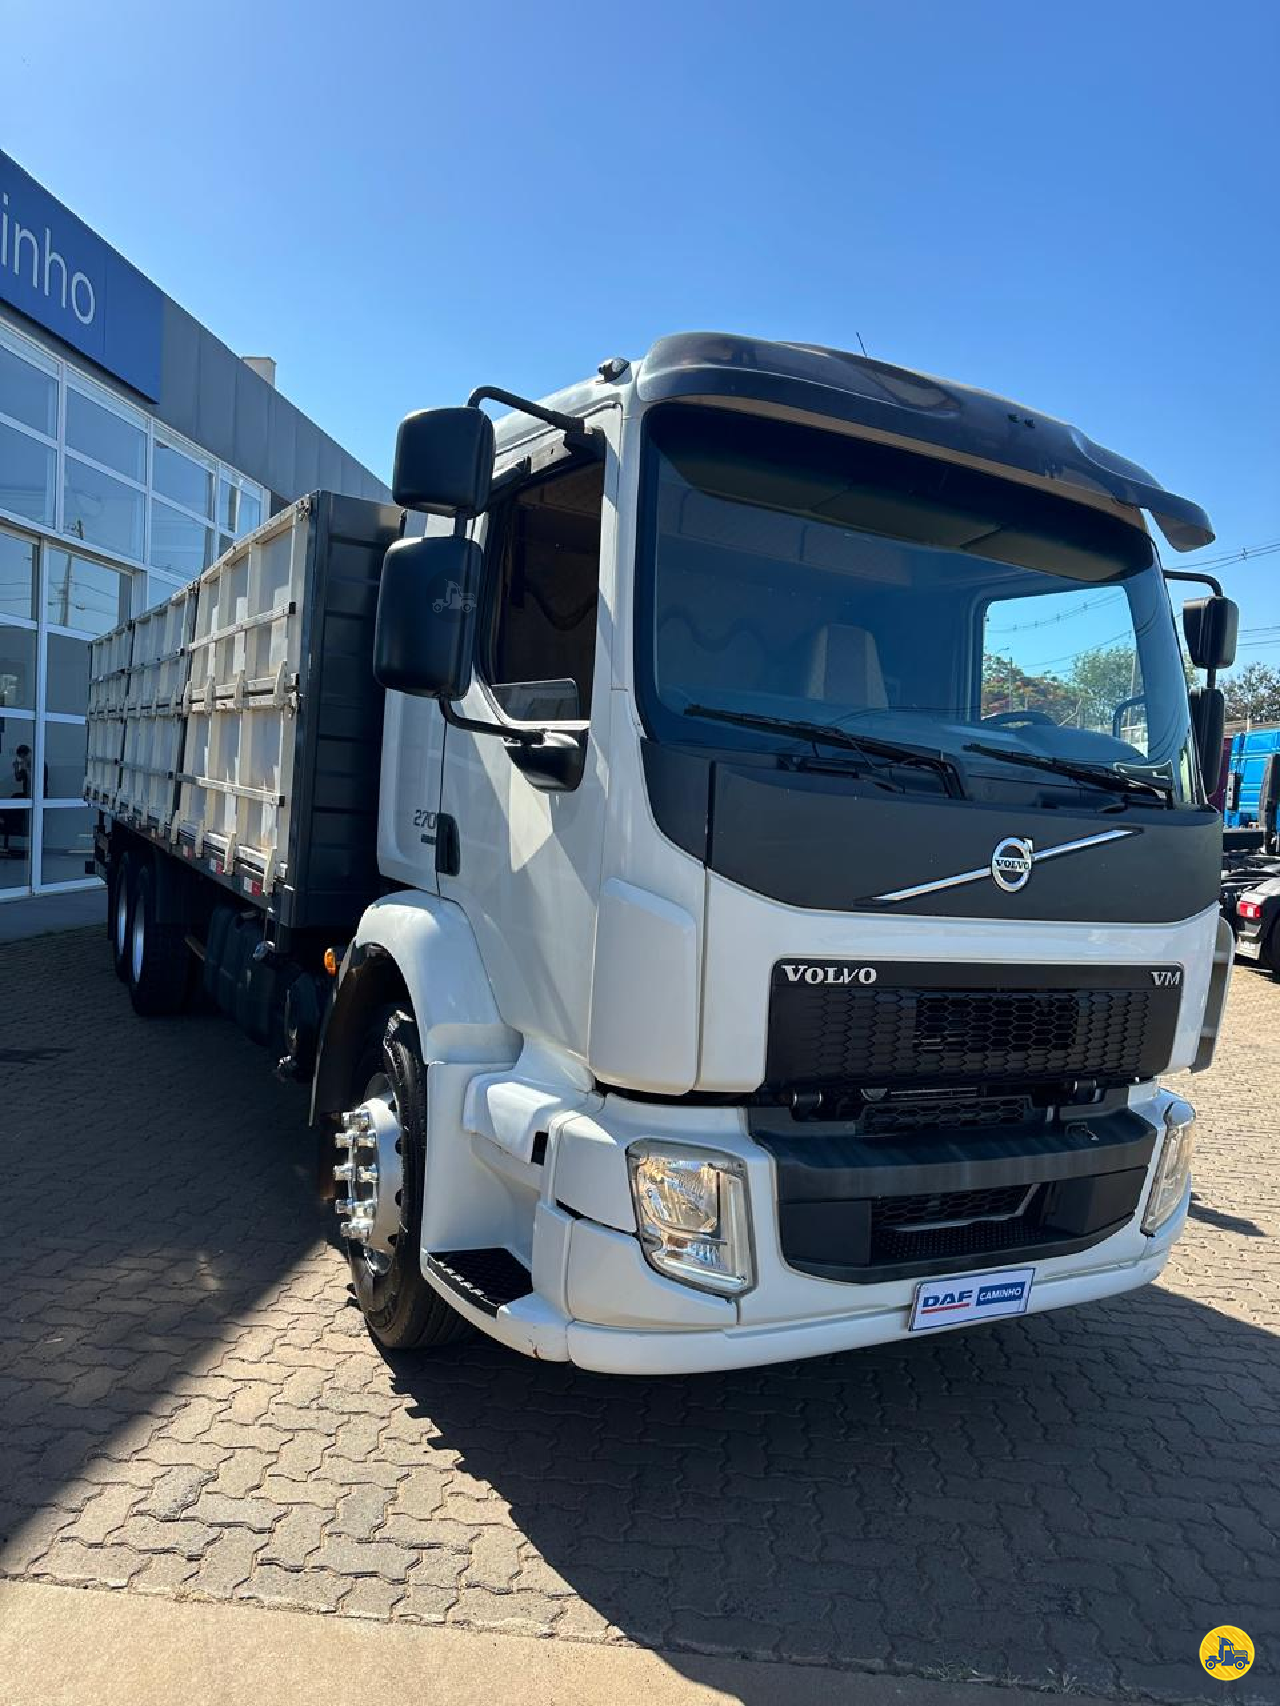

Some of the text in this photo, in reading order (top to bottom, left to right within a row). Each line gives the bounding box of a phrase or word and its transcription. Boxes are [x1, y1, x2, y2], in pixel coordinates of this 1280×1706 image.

[0, 192, 96, 325] inho
[414, 809, 437, 829] 270
[995, 859, 1030, 870] VOLVO
[781, 964, 877, 985] VOLVO
[1151, 971, 1181, 986] VM
[922, 1287, 1022, 1308] DAF CAMINHO
